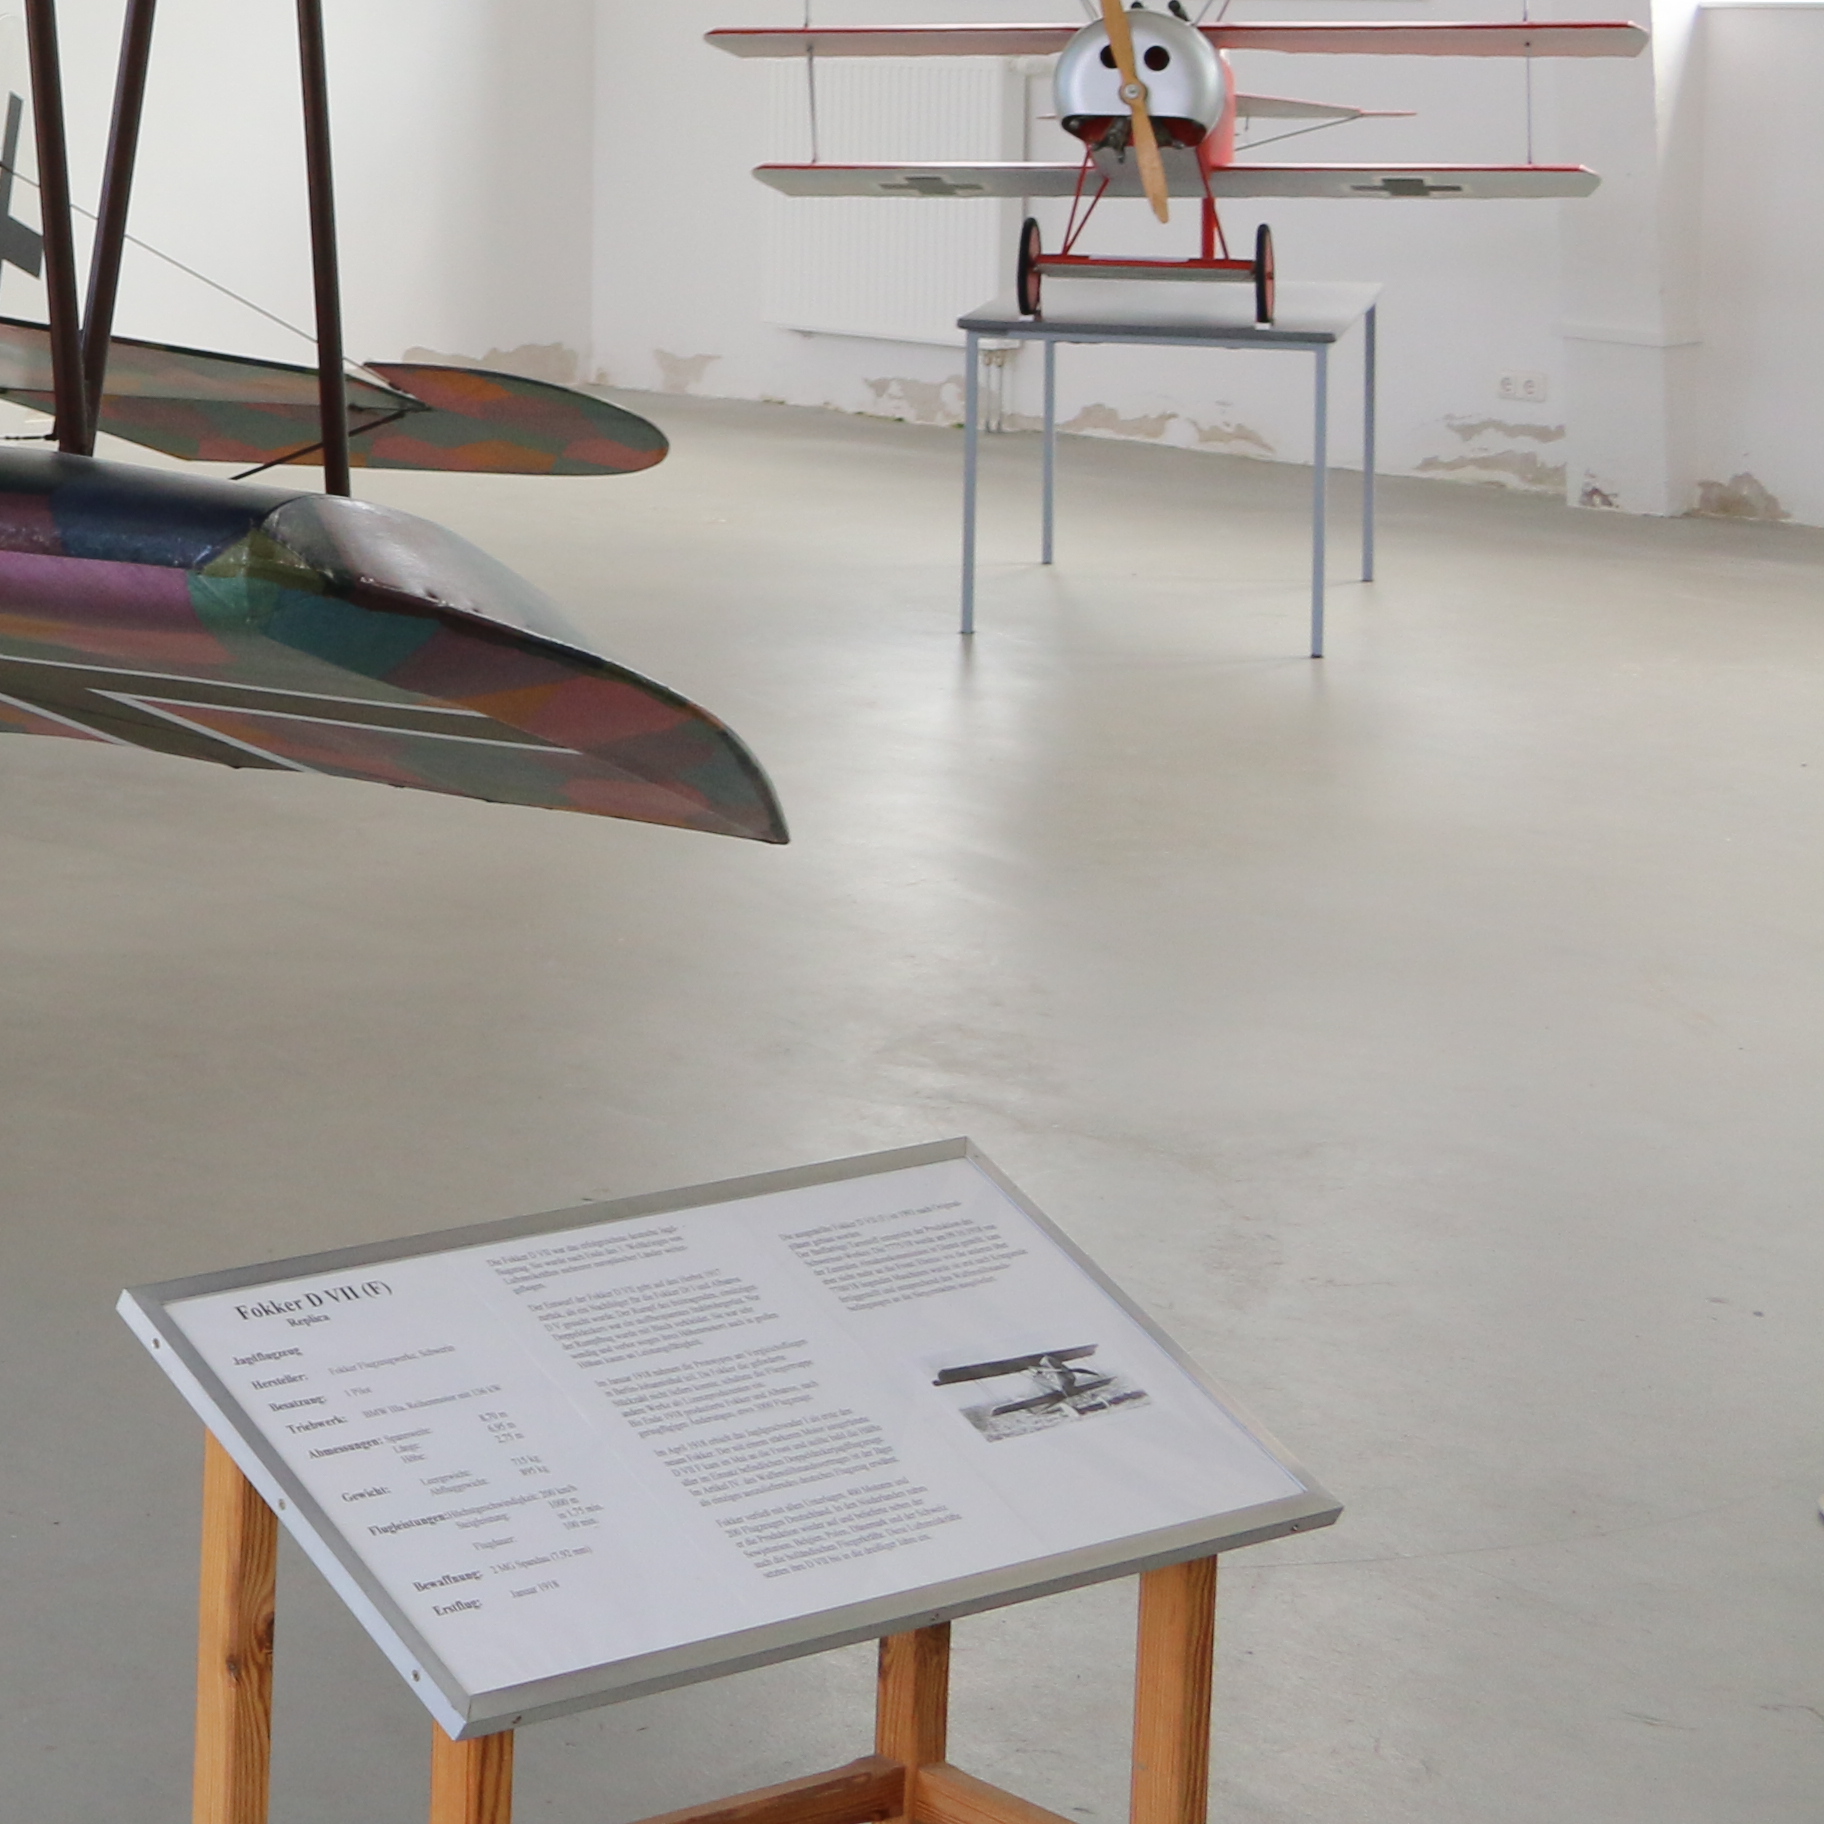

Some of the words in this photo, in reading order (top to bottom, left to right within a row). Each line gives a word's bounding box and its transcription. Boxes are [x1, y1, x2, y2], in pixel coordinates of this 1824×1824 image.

[235, 1300, 303, 1321] Fokker
[305, 1294, 324, 1308] D
[324, 1286, 360, 1302] VII
[362, 1282, 393, 1298] (F)
[286, 1315, 331, 1328] Replica
[233, 1348, 303, 1366] Jagdflugzeug
[252, 1374, 309, 1391] Hersteller:
[269, 1396, 327, 1412] Besatzung:
[286, 1416, 348, 1434] Triebwerk:
[309, 1438, 384, 1459] Abmessungen:
[342, 1487, 391, 1502] Gewicht:
[413, 1571, 483, 1592] Bewaffnung:
[433, 1600, 483, 1617] Erstflug:
